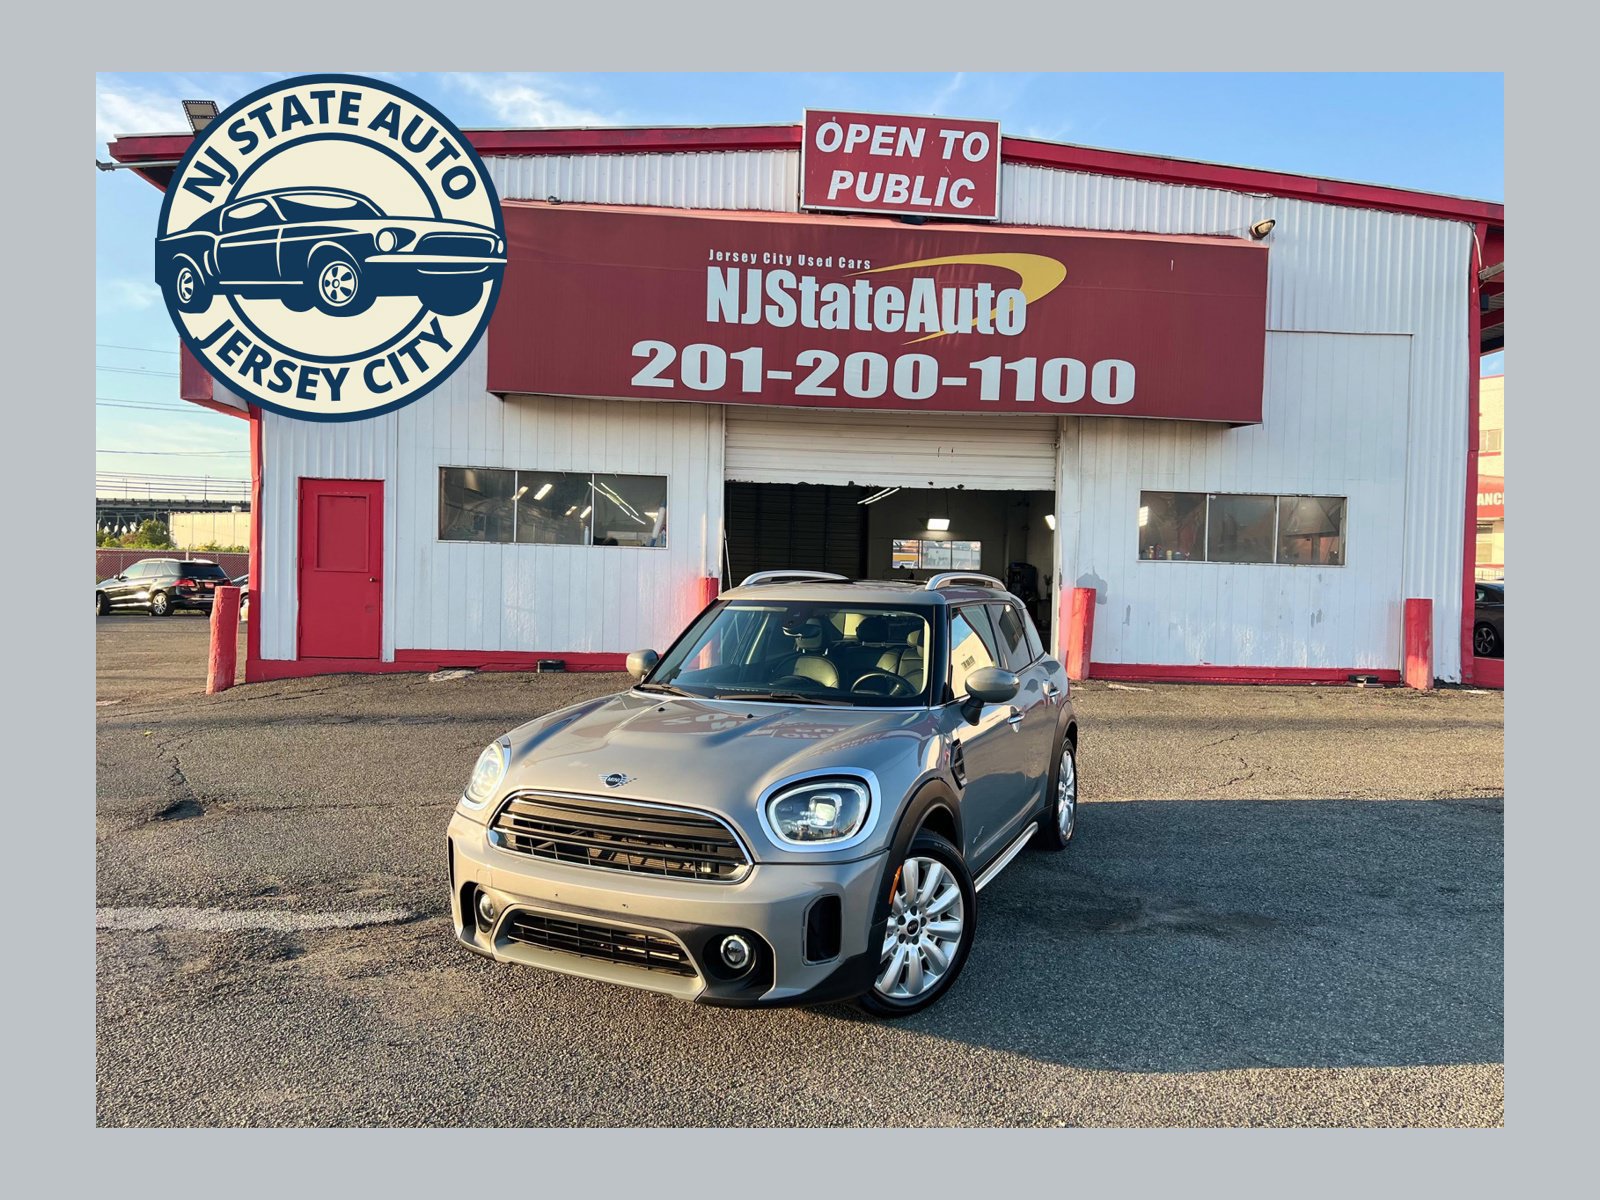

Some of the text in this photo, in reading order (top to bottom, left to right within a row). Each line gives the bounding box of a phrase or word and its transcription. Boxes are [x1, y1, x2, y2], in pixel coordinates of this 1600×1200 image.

[816, 121, 990, 163] OPEN TO
[827, 170, 976, 209] PUBLIC
[709, 248, 871, 270] Jersey City Used Cars
[706, 266, 1028, 336] NJStateAuto
[631, 340, 1136, 405] 201-200-1100
[1477, 492, 1504, 506] ANC
